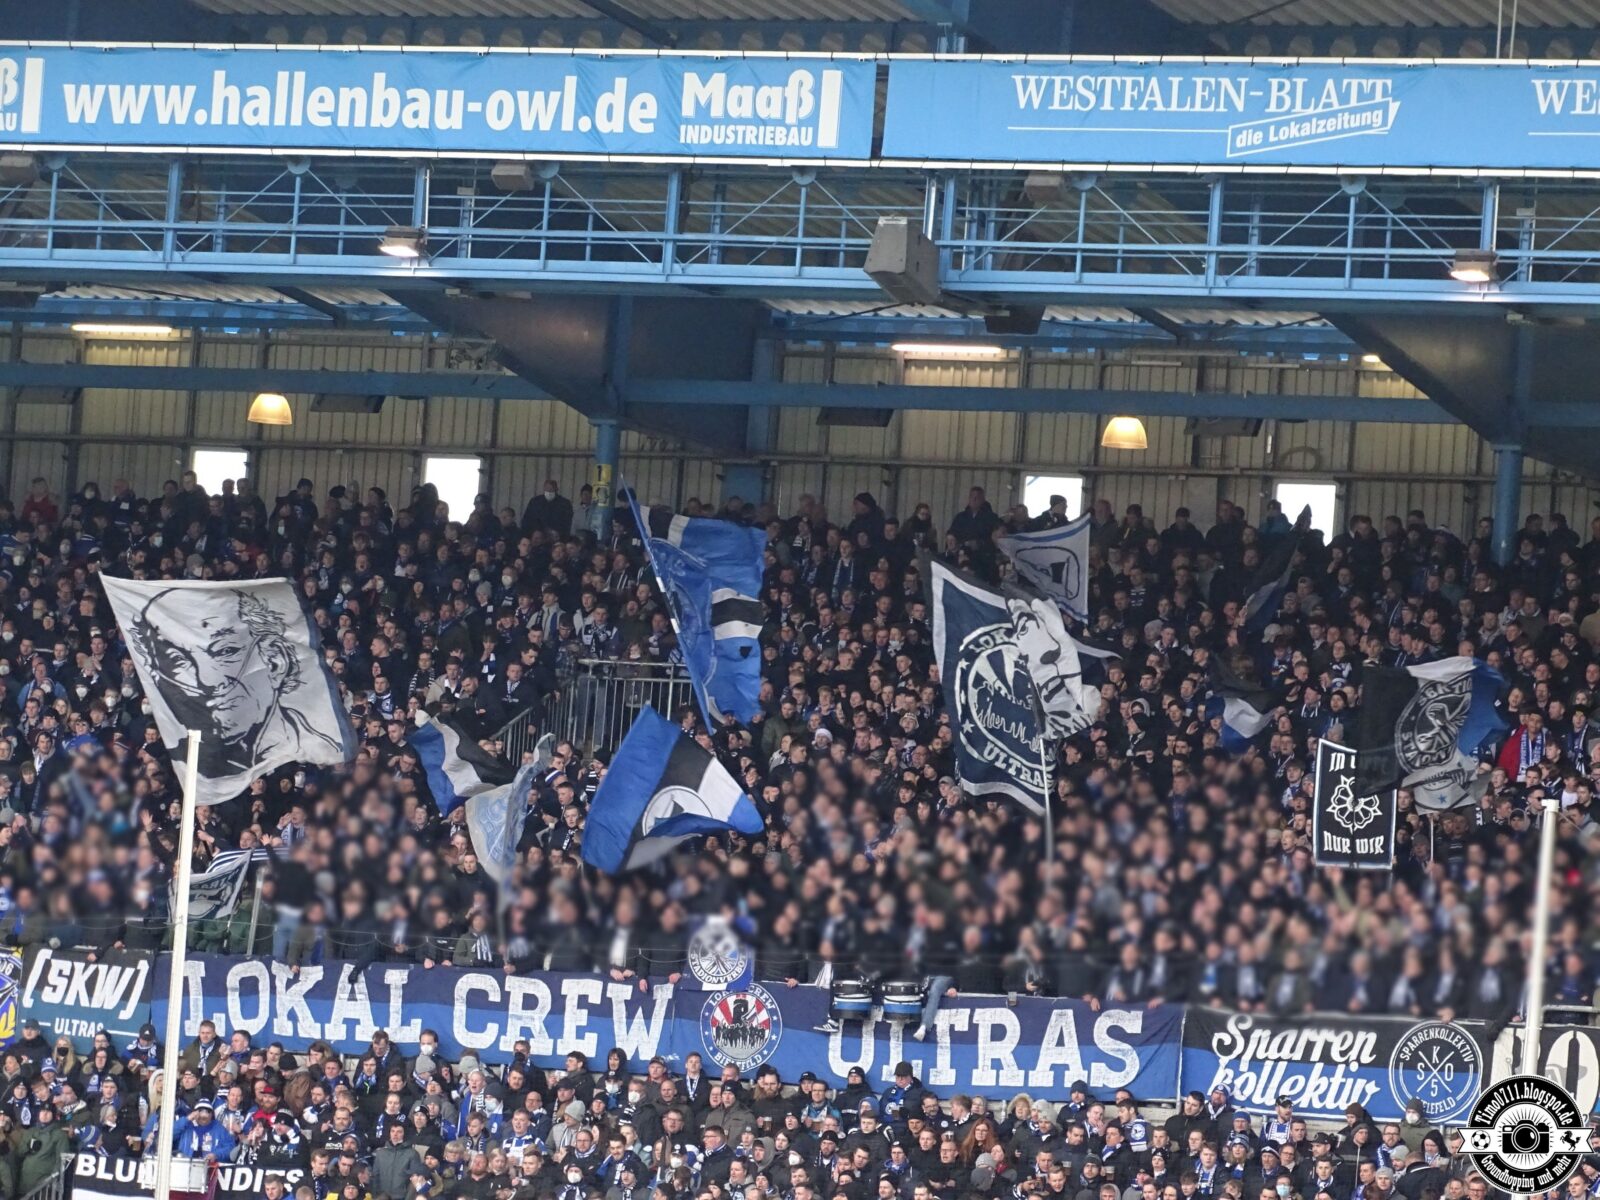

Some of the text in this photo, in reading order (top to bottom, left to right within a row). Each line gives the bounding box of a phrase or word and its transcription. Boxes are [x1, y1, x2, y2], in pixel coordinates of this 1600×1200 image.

[63, 70, 658, 134] www.hallenbau-owl.de
[680, 69, 816, 125] Maaß
[1012, 75, 1393, 113] WESTFALEN-BLATT
[679, 125, 813, 146] INDUSTRIEBAU
[1236, 108, 1384, 149] die Lokalzeitung
[1355, 835, 1384, 855] WIR
[184, 960, 674, 1061] LOKAL CREW
[828, 1005, 1144, 1089] ULTRAS
[1211, 1013, 1378, 1072] Sparren
[1399, 1028, 1475, 1064] SPARRENKOLLEKTIV
